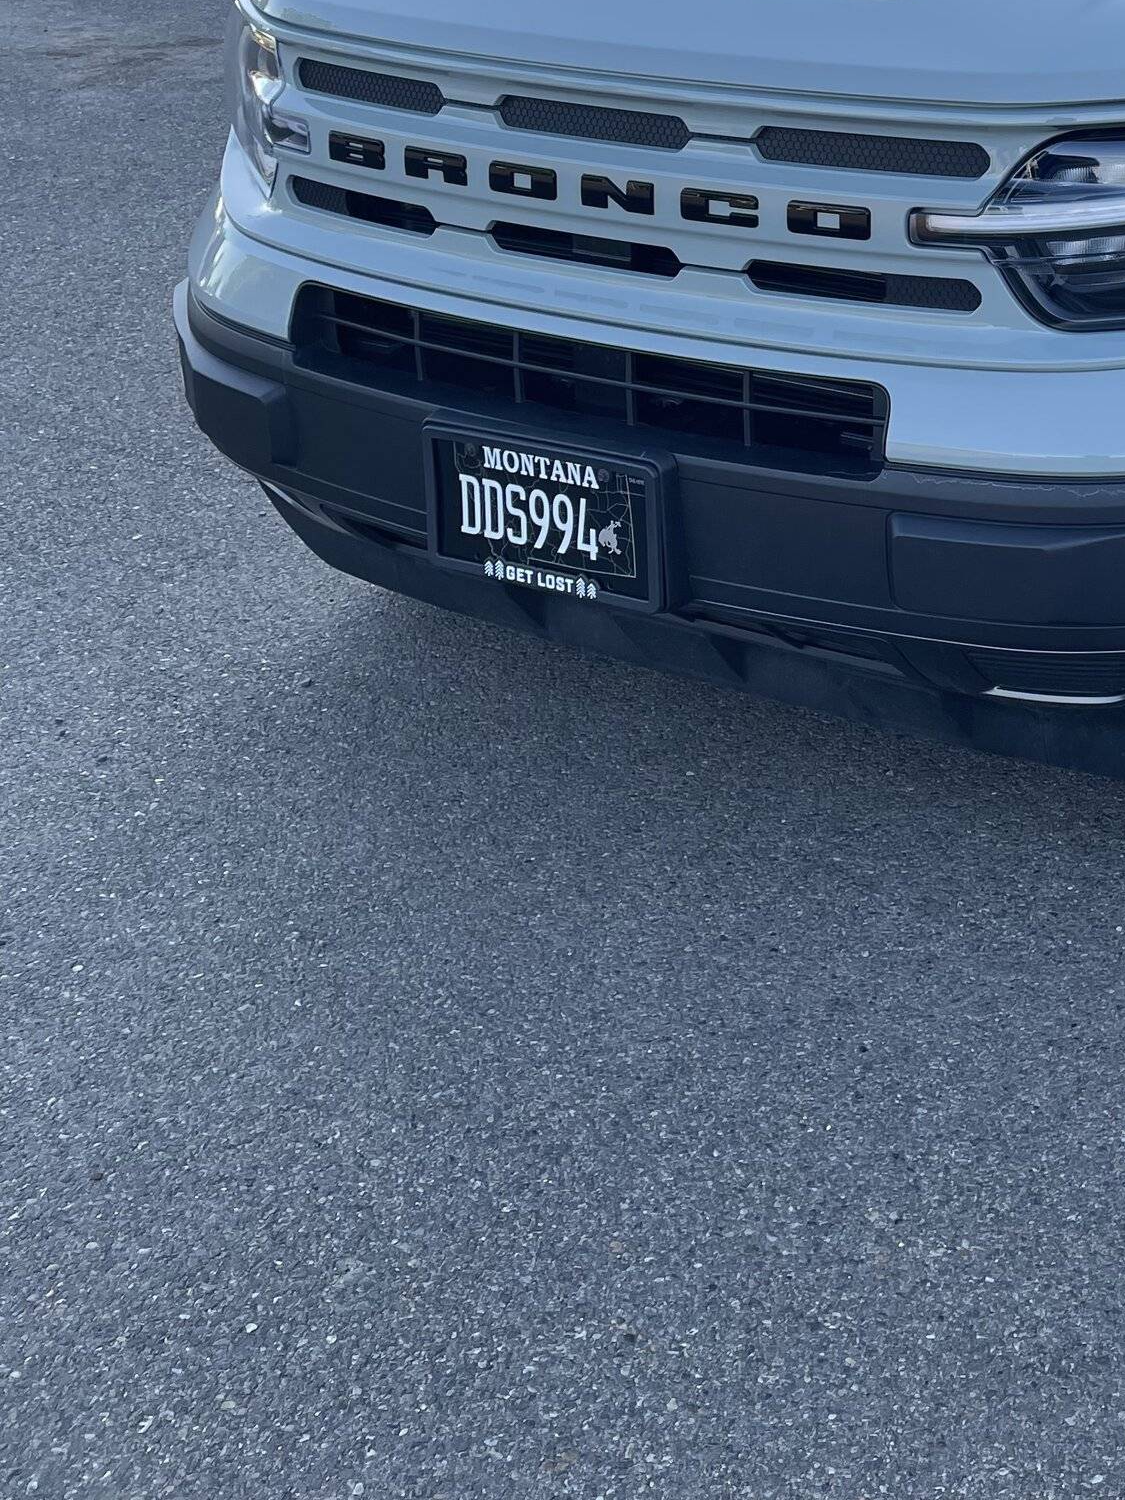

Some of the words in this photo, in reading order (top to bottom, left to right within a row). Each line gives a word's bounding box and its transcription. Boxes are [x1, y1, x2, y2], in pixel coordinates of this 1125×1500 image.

[328, 128, 872, 241] BRONCO
[481, 445, 600, 489] MONTANA
[458, 473, 599, 561] DDS994
[505, 565, 534, 585] GET
[537, 571, 574, 593] LOST
